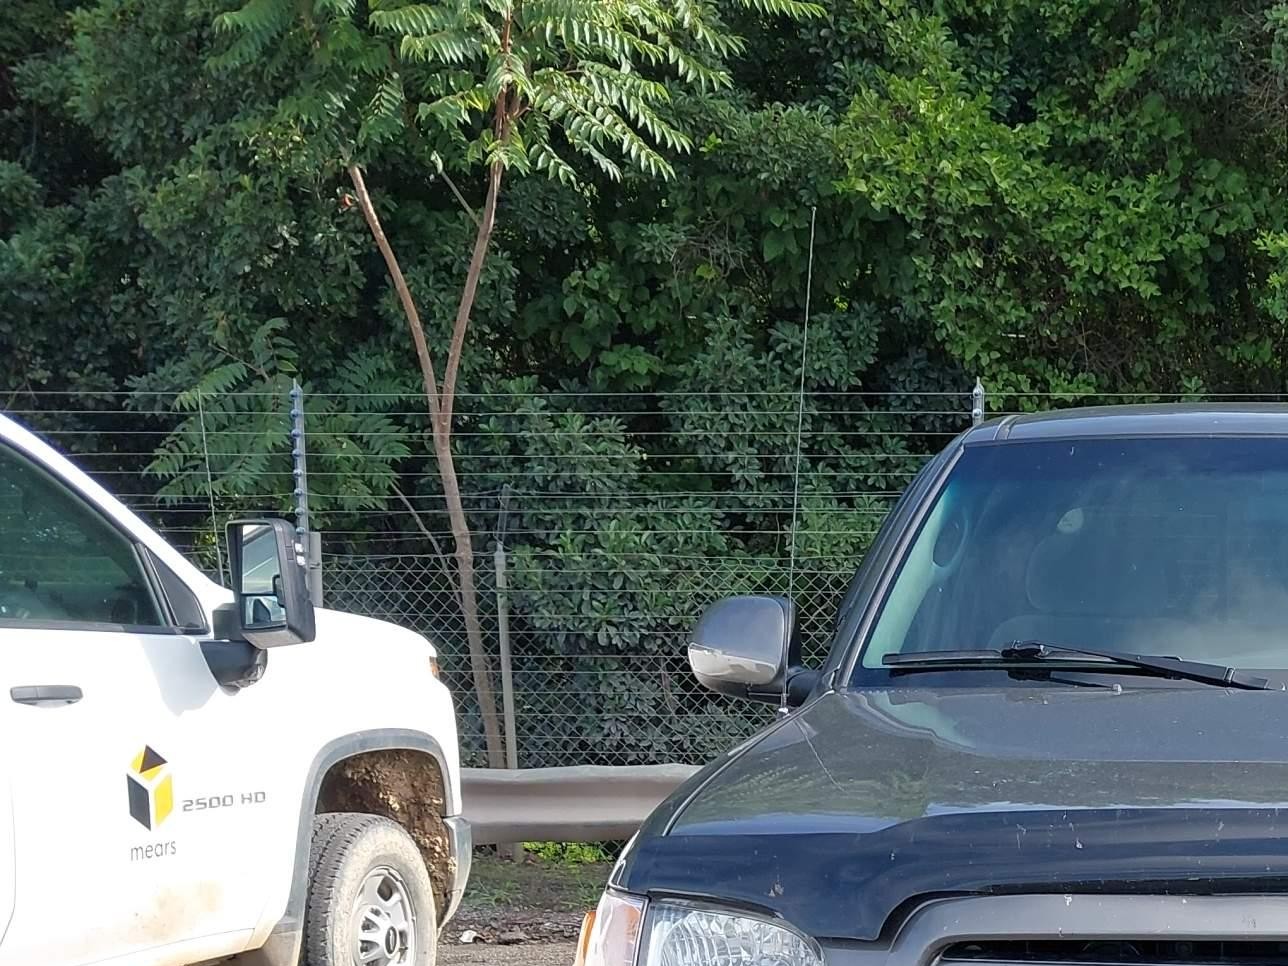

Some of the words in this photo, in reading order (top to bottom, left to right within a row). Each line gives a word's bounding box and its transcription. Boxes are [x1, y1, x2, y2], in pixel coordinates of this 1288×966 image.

[182, 795, 234, 812] 2500
[241, 791, 266, 805] HD
[130, 840, 177, 862] mears
